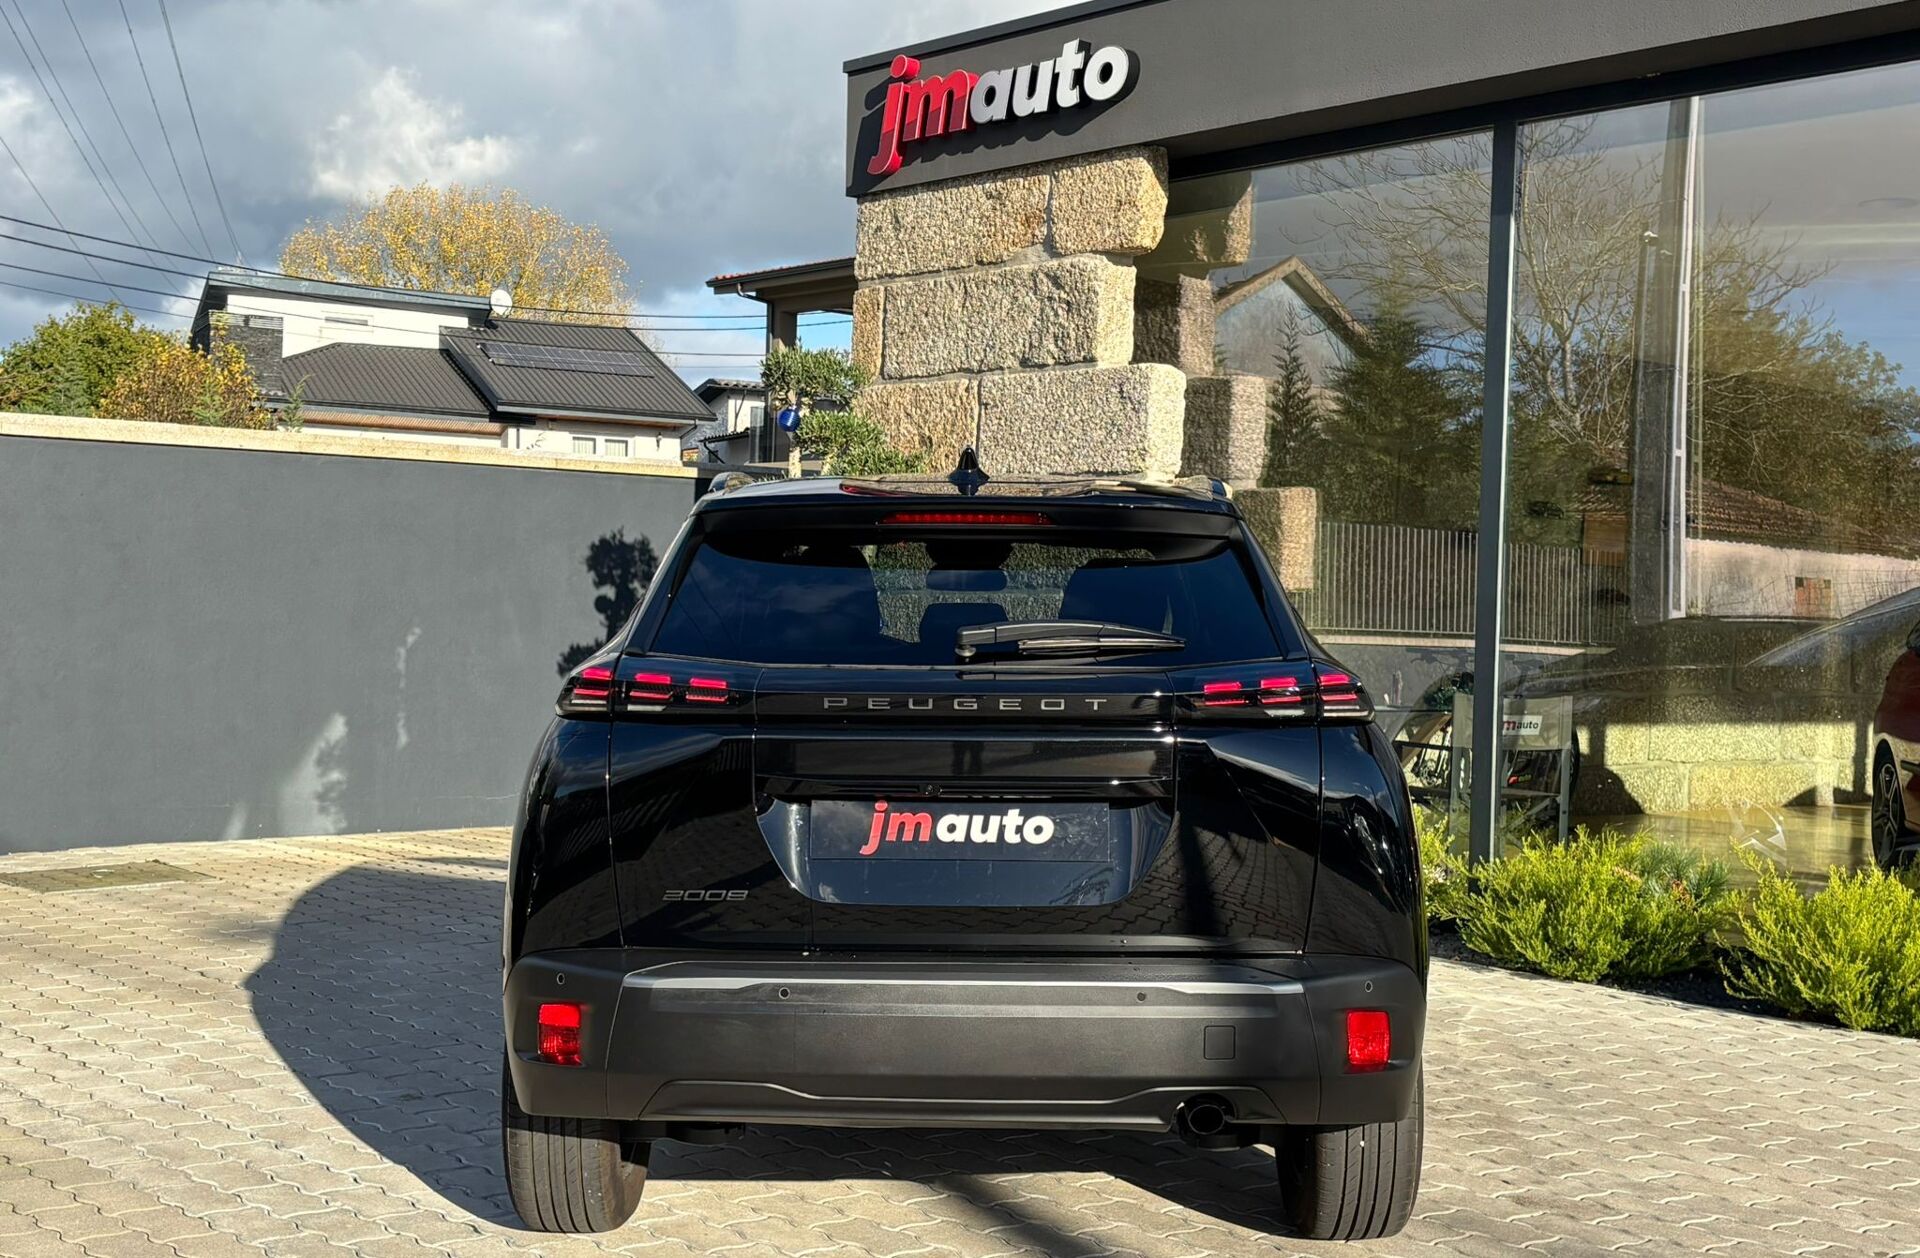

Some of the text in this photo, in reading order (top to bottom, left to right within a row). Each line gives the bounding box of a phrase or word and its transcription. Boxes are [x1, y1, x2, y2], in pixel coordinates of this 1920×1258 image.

[867, 38, 1130, 175] jmauto
[823, 698, 1107, 710] PEUGEOT
[1503, 720, 1539, 731] mauto
[859, 800, 1055, 855] jmauto
[662, 889, 749, 901] 2008
